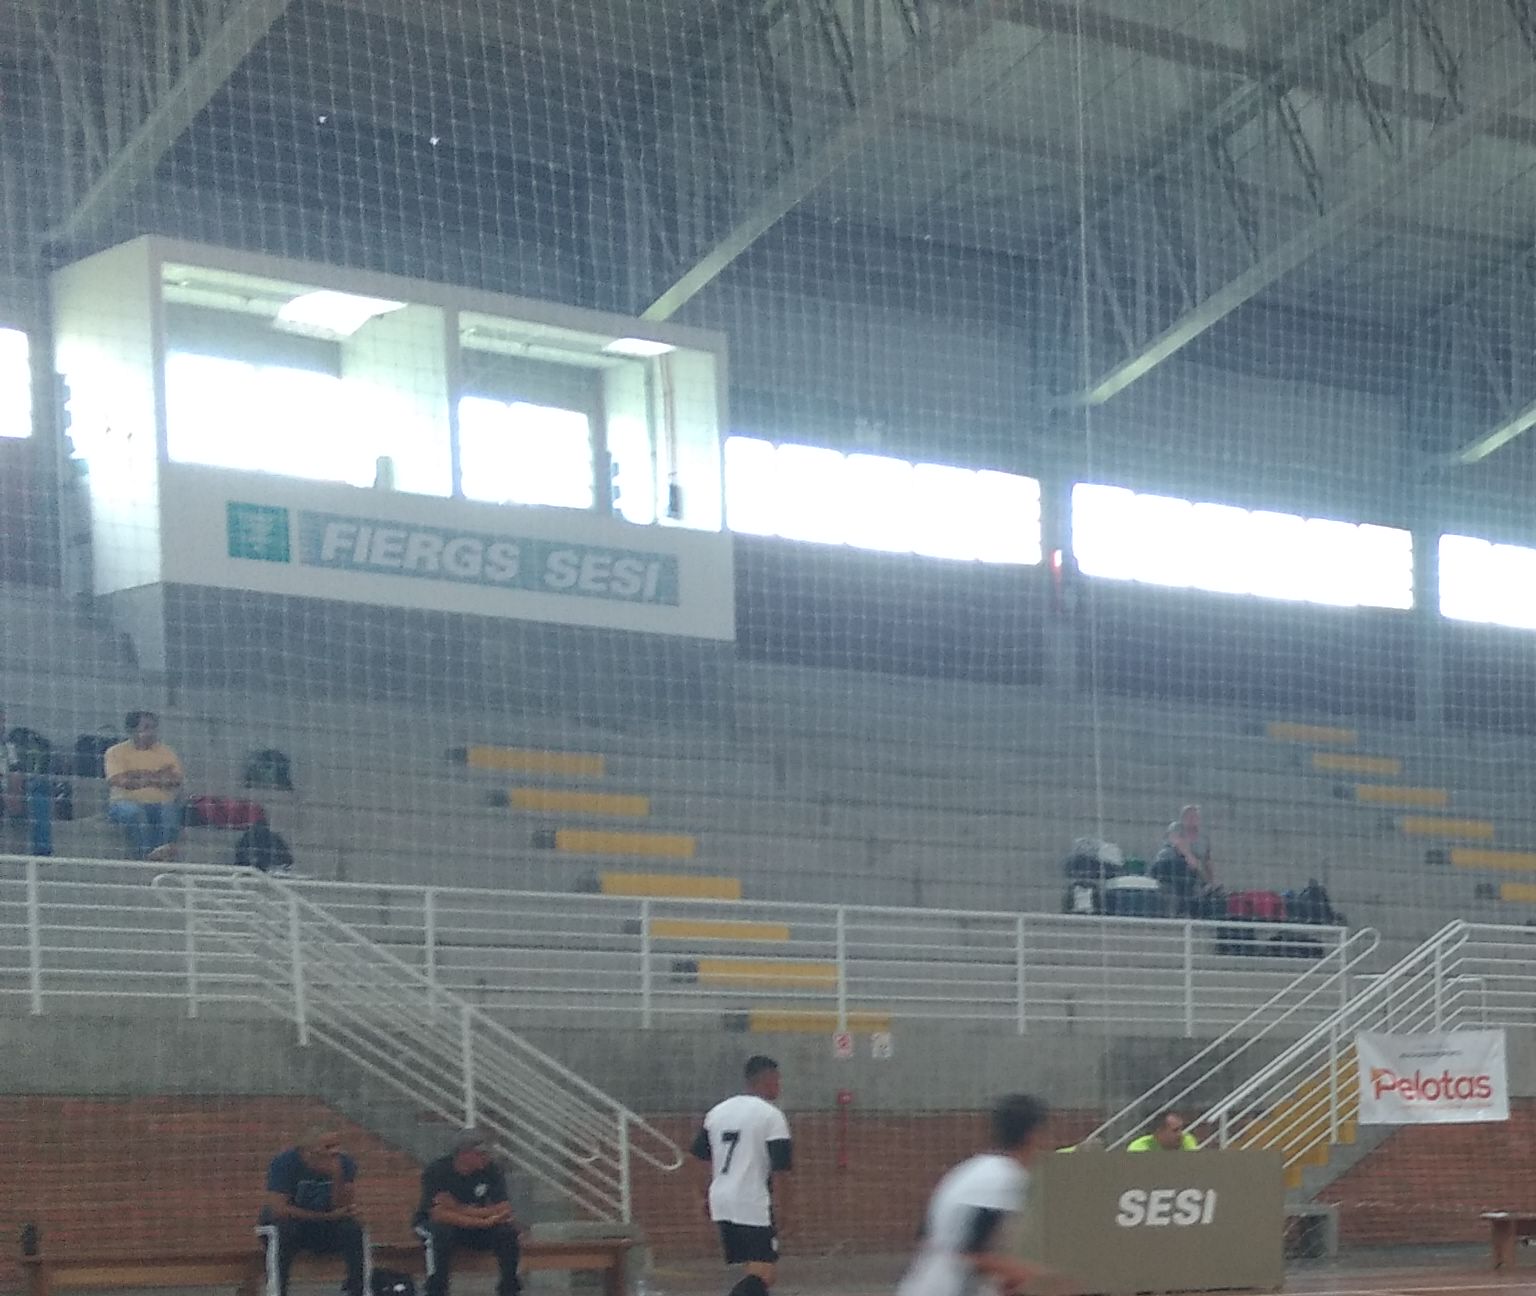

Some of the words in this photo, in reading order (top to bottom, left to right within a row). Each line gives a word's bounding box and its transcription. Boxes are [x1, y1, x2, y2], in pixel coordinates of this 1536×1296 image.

[321, 522, 520, 581] FIERGS
[543, 549, 662, 597] SESI
[1370, 1068, 1493, 1101] Pelotas
[721, 1130, 741, 1175] 7
[1116, 1188, 1217, 1227] SESI
